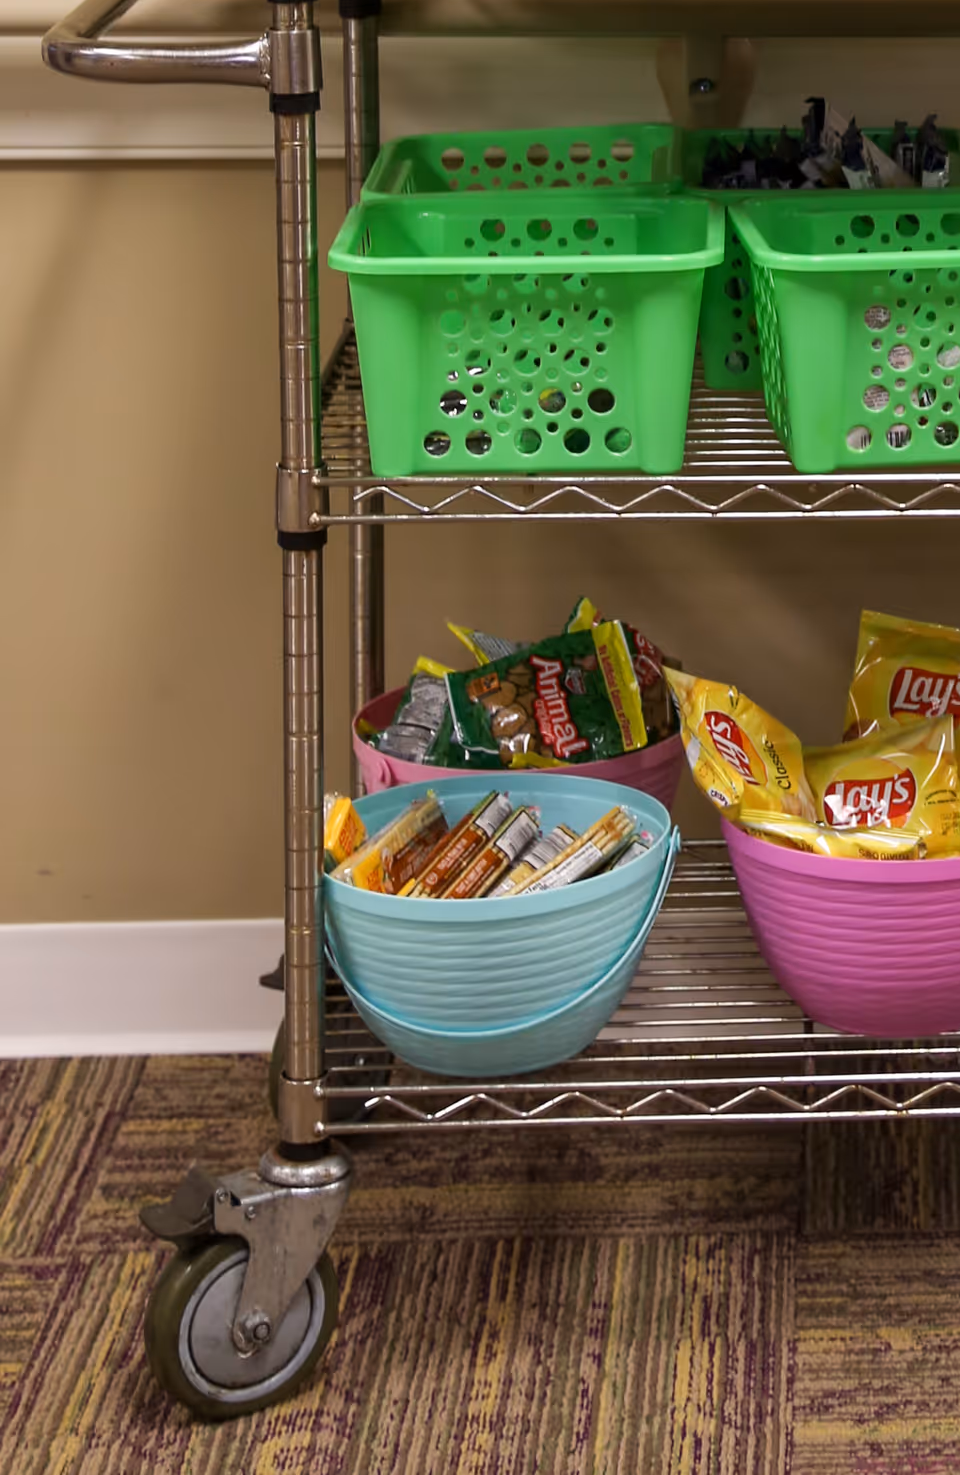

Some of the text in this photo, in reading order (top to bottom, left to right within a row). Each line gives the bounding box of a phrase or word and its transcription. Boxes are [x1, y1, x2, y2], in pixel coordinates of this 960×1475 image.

[531, 656, 588, 757] Animal
[763, 739, 792, 790] Classic
[832, 773, 911, 825] Lay's
